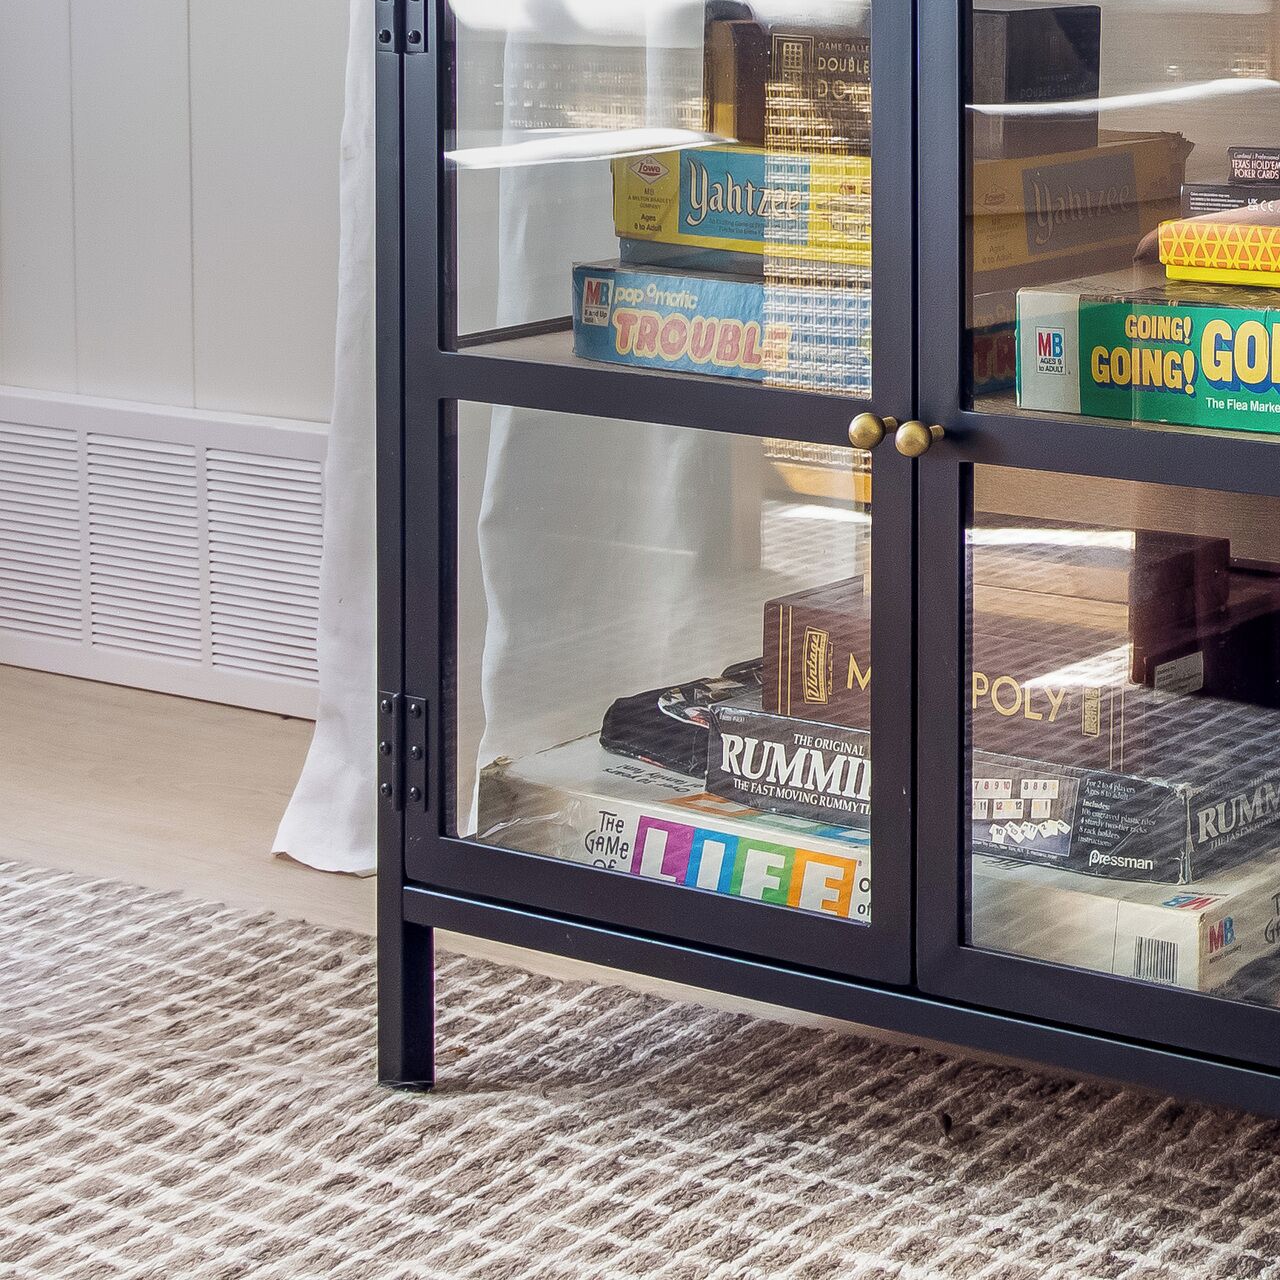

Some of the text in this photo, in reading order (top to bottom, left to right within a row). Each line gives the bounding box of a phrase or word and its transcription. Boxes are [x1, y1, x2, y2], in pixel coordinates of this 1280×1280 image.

[818, 57, 870, 74] DOUBLE
[1232, 159, 1280, 170] TEXAS HOLD'EM
[1235, 169, 1280, 179] POKER CARDS
[686, 157, 802, 226] Yahtzee
[585, 280, 609, 305] MB
[1125, 314, 1192, 345] GOING!
[1038, 332, 1063, 358] MB
[1045, 365, 1063, 373] ADULT
[1090, 345, 1196, 395] GOING!
[1206, 398, 1225, 409] The
[1227, 399, 1248, 411] Flea
[806, 634, 820, 697] Vintage
[794, 733, 865, 757] THE ORIGINAL
[733, 778, 862, 813] THE FAST MOVING RUMMY
[1082, 798, 1111, 810] Includes:
[640, 827, 845, 917] LIFE
[1208, 916, 1237, 954] MB
